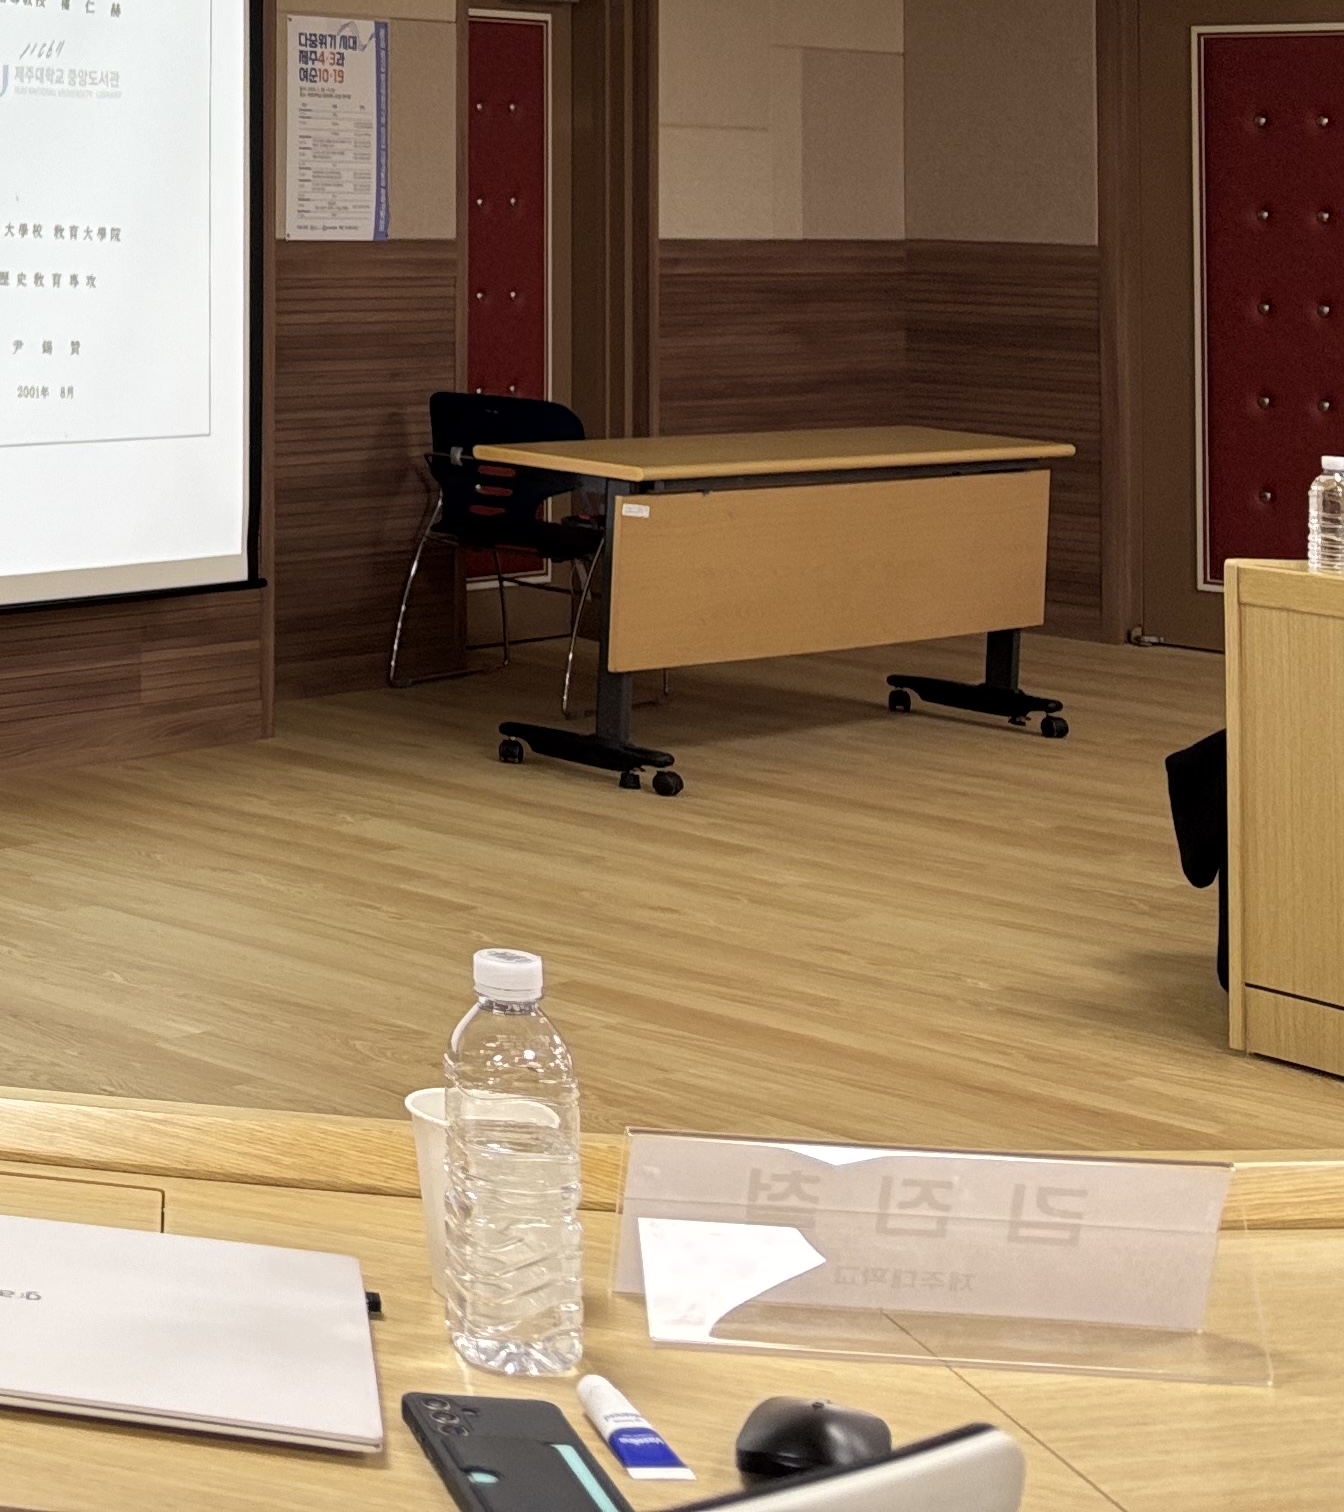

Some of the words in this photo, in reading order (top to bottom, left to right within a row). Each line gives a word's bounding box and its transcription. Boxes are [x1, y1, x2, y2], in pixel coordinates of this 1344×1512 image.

[299, 32, 336, 50] 다중위기
[14, 66, 64, 84] 제주대학교
[68, 68, 120, 88] 중앙도서관
